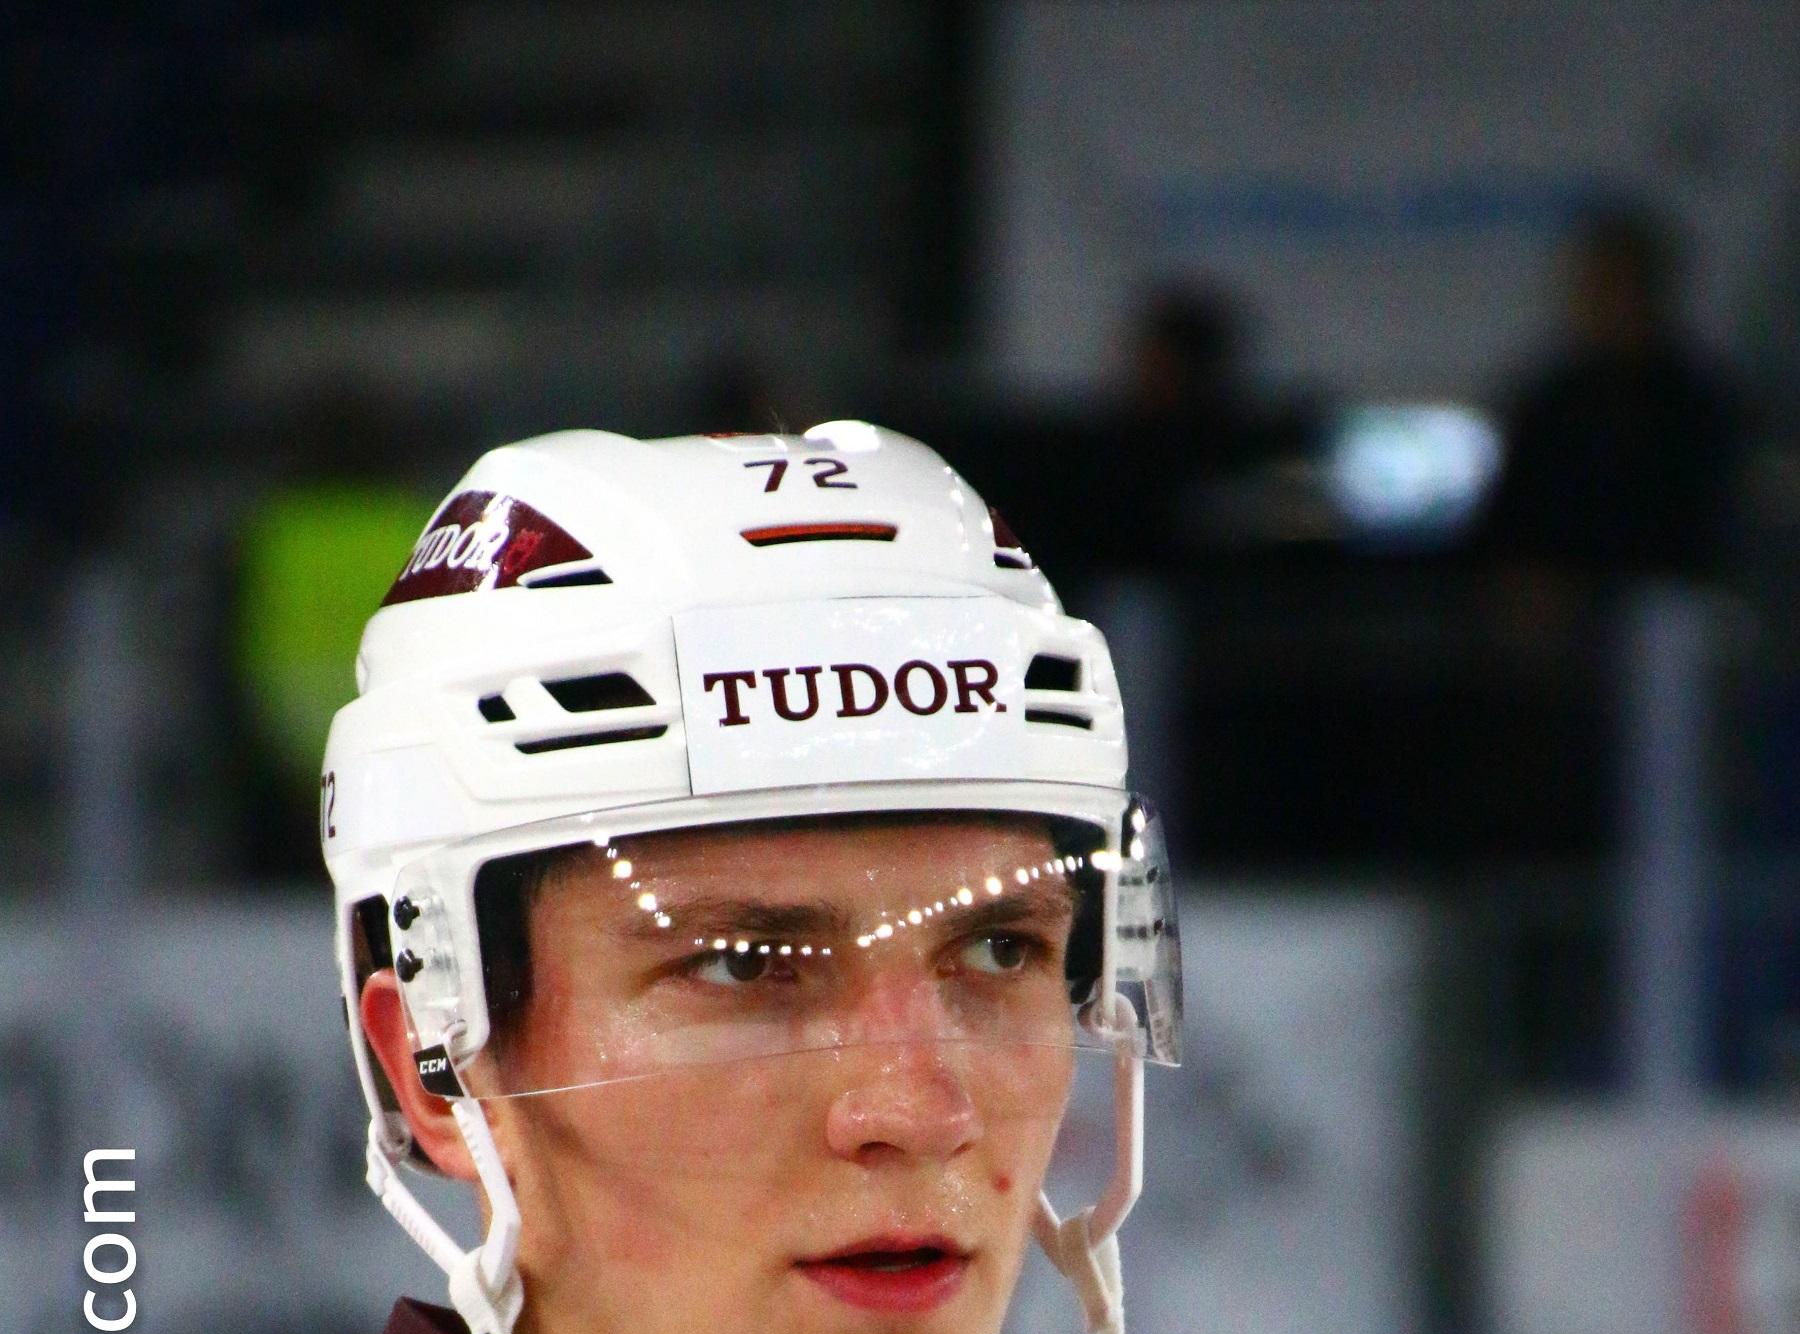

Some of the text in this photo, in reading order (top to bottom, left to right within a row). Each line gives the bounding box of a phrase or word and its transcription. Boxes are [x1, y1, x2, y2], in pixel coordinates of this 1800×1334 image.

[743, 457, 858, 493] 72
[703, 658, 1007, 728] TUDOR
[419, 1057, 447, 1075] CCM
